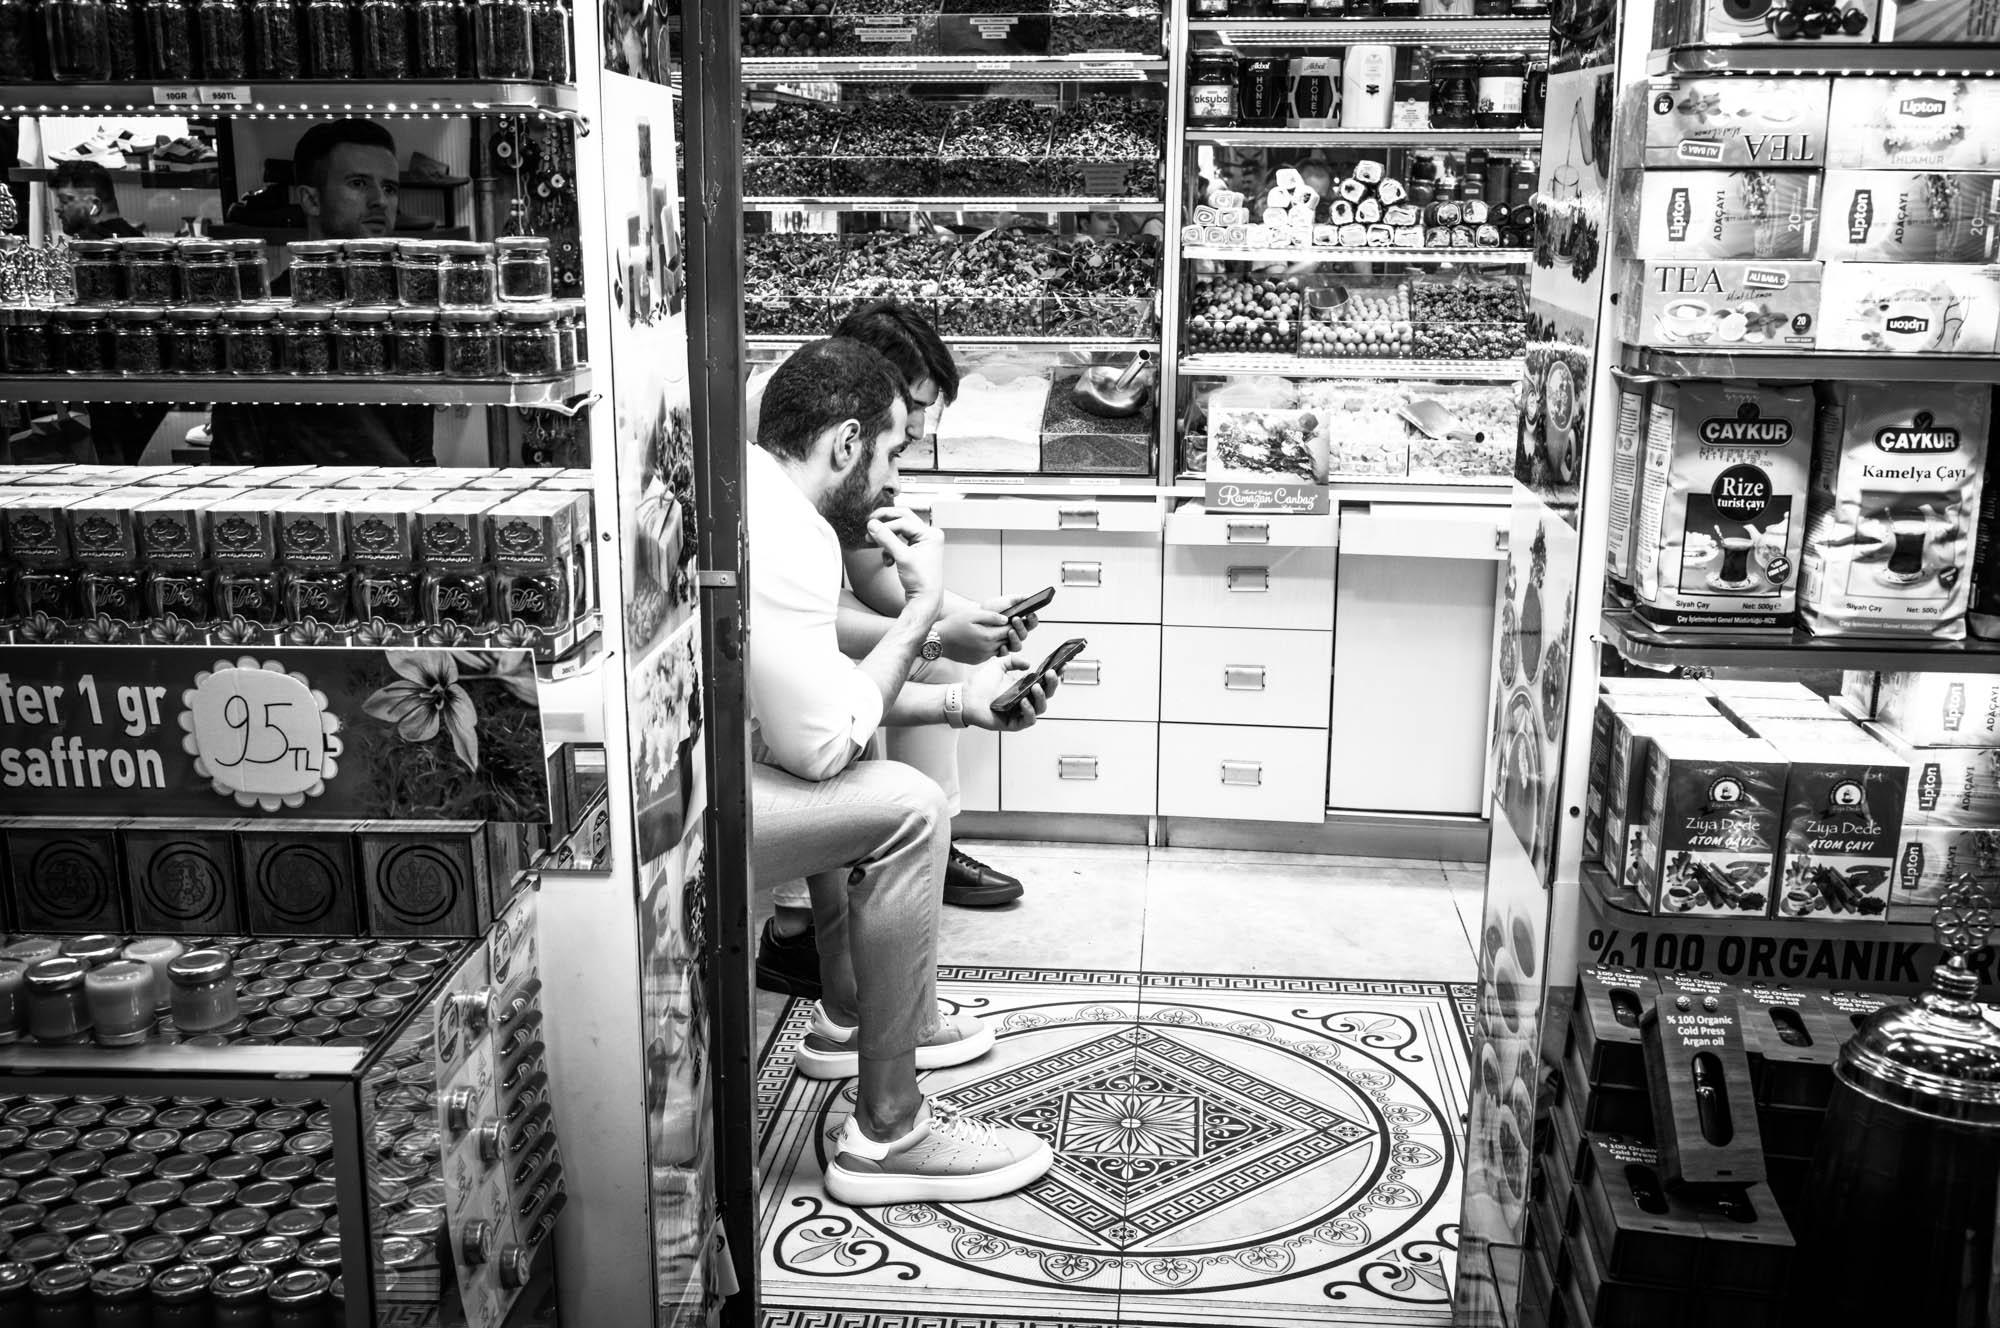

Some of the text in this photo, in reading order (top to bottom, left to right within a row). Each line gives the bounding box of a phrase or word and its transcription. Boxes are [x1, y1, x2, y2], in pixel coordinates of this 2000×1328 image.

[166, 92, 188, 100] 10GR
[1256, 76, 1264, 116] HONEY
[1902, 100, 1943, 115] Lipton
[1743, 132, 1814, 162] TEA
[1670, 192, 1687, 238] Lipton
[1788, 214, 1801, 232] 20
[1851, 193, 1869, 240] Lipton
[1970, 217, 1984, 236] 20
[1655, 266, 1725, 293] TEA
[1796, 316, 1806, 325] 20
[1889, 320, 1926, 332] Lipton
[1706, 423, 1787, 442] ÇAYKUR
[1880, 432, 1955, 451] ÇAYKUR
[1863, 465, 1966, 482] Kamelya Çayı
[1721, 477, 1764, 496] Rize
[1217, 485, 1315, 510] Ramazan Canbaz
[1717, 498, 1765, 511] turist çayı
[1676, 600, 1695, 608] Siyah
[78, 674, 103, 725] 1
[117, 685, 167, 737] gr
[1946, 686, 1962, 728] Lipton
[0, 736, 166, 788] saffron
[1921, 767, 1937, 808] Lipton
[1686, 815, 1760, 835] Ziya Dede
[1806, 820, 1882, 838] Ziya Dede
[1688, 836, 1724, 845] ATOM
[1808, 840, 1874, 853] ATOM ÇAYI
[1904, 846, 1919, 887] Lipton
[1666, 1015, 1733, 1026] % 100 Organic
[1677, 1026, 1726, 1036] Cold Press
[1682, 1037, 1725, 1047] Argan oil
